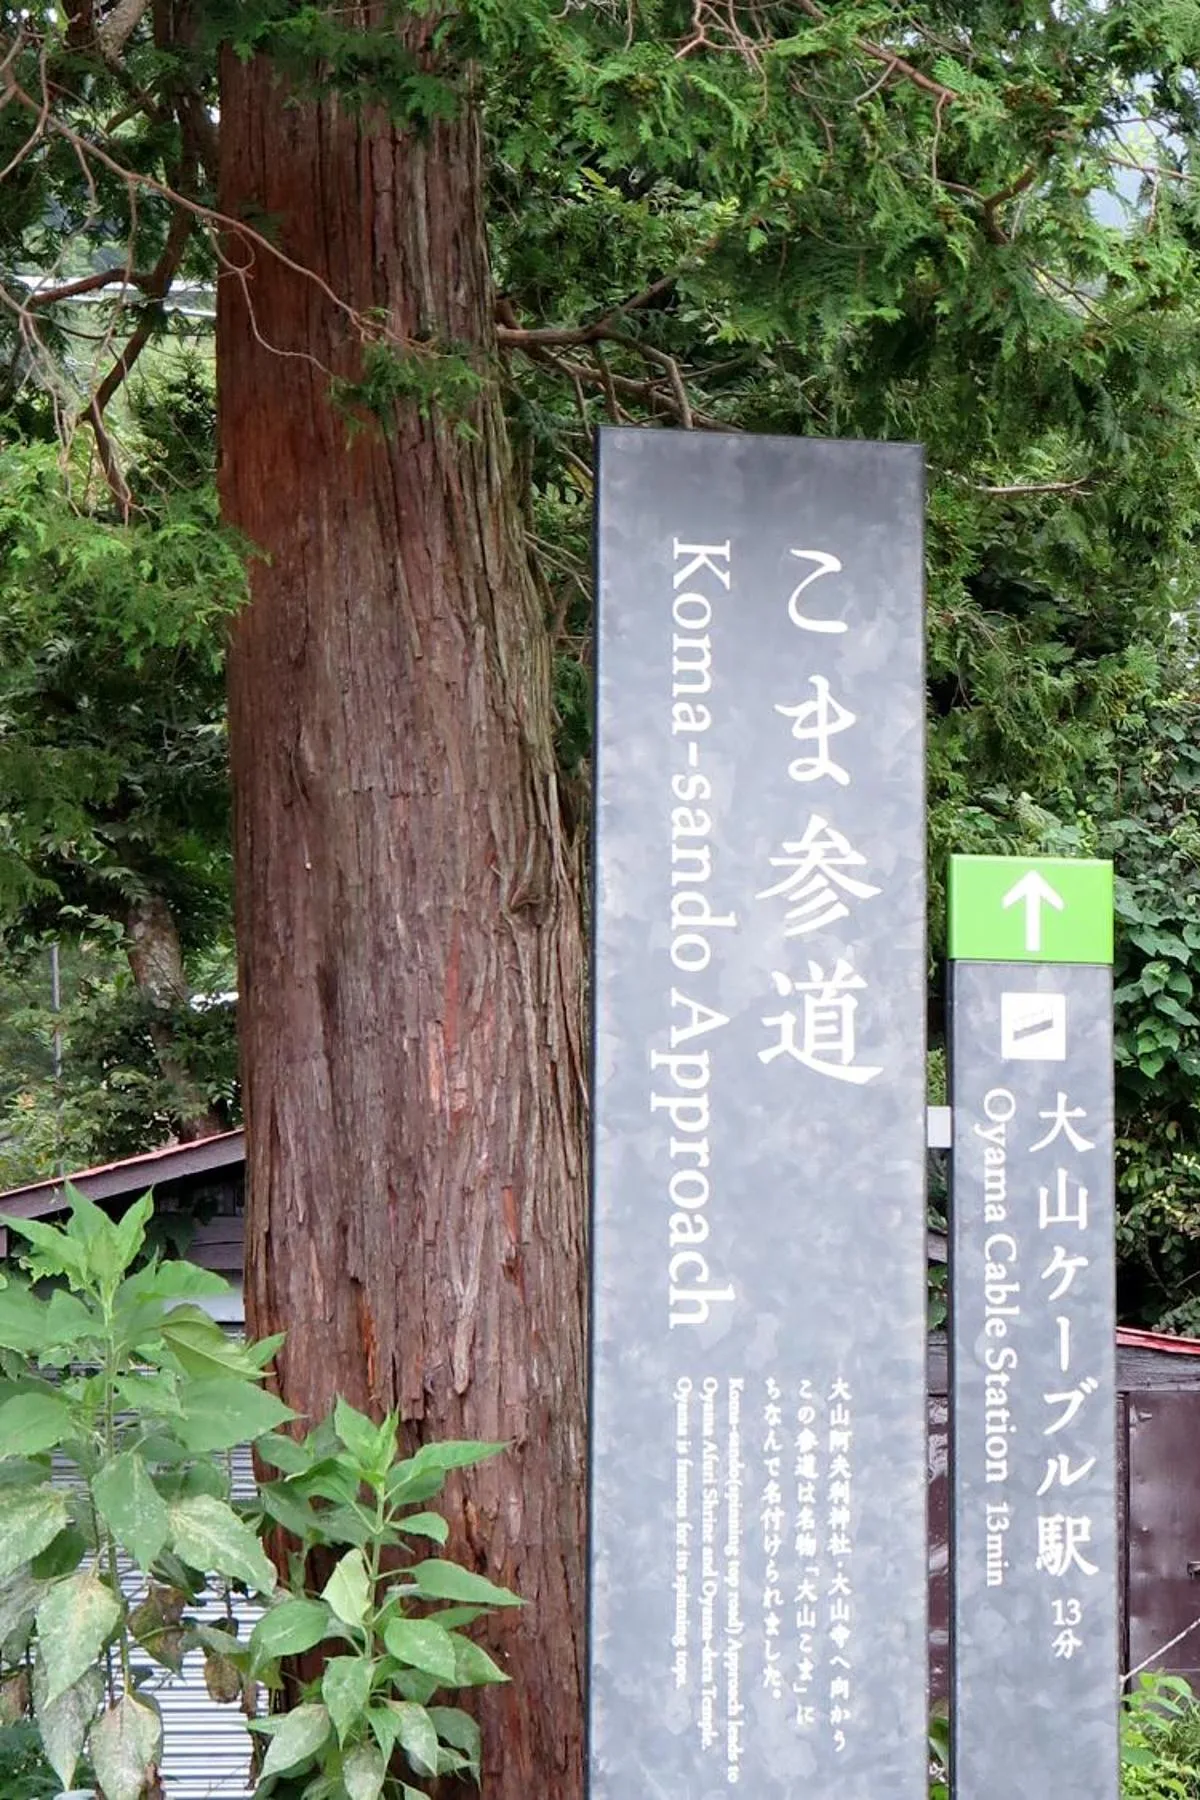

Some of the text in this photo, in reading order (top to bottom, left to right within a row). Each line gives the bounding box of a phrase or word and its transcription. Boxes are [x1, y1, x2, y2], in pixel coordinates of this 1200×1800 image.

[755, 548, 884, 1085] こま参道
[650, 537, 737, 1329] Koma-sando Approach
[975, 1087, 1020, 1587] Oyama Cable Station 13min
[1029, 1091, 1099, 1577] 大山ケーブル駅
[673, 1376, 693, 1436] Oyama
[699, 1377, 719, 1436] Oyama
[676, 1440, 691, 1454] is
[702, 1440, 719, 1484] Afuri
[676, 1458, 694, 1518] famous
[702, 1488, 718, 1543] Shrine
[676, 1522, 693, 1547] for
[702, 1547, 718, 1577] and
[760, 1376, 786, 1700] ちなんで名付けられました。
[724, 1560, 739, 1588] top
[671, 1575, 692, 1647] spinning
[698, 1580, 718, 1682] Oyama-dera
[724, 1638, 744, 1716] Approach
[728, 1720, 744, 1762] leads
[728, 1765, 739, 1784] to
